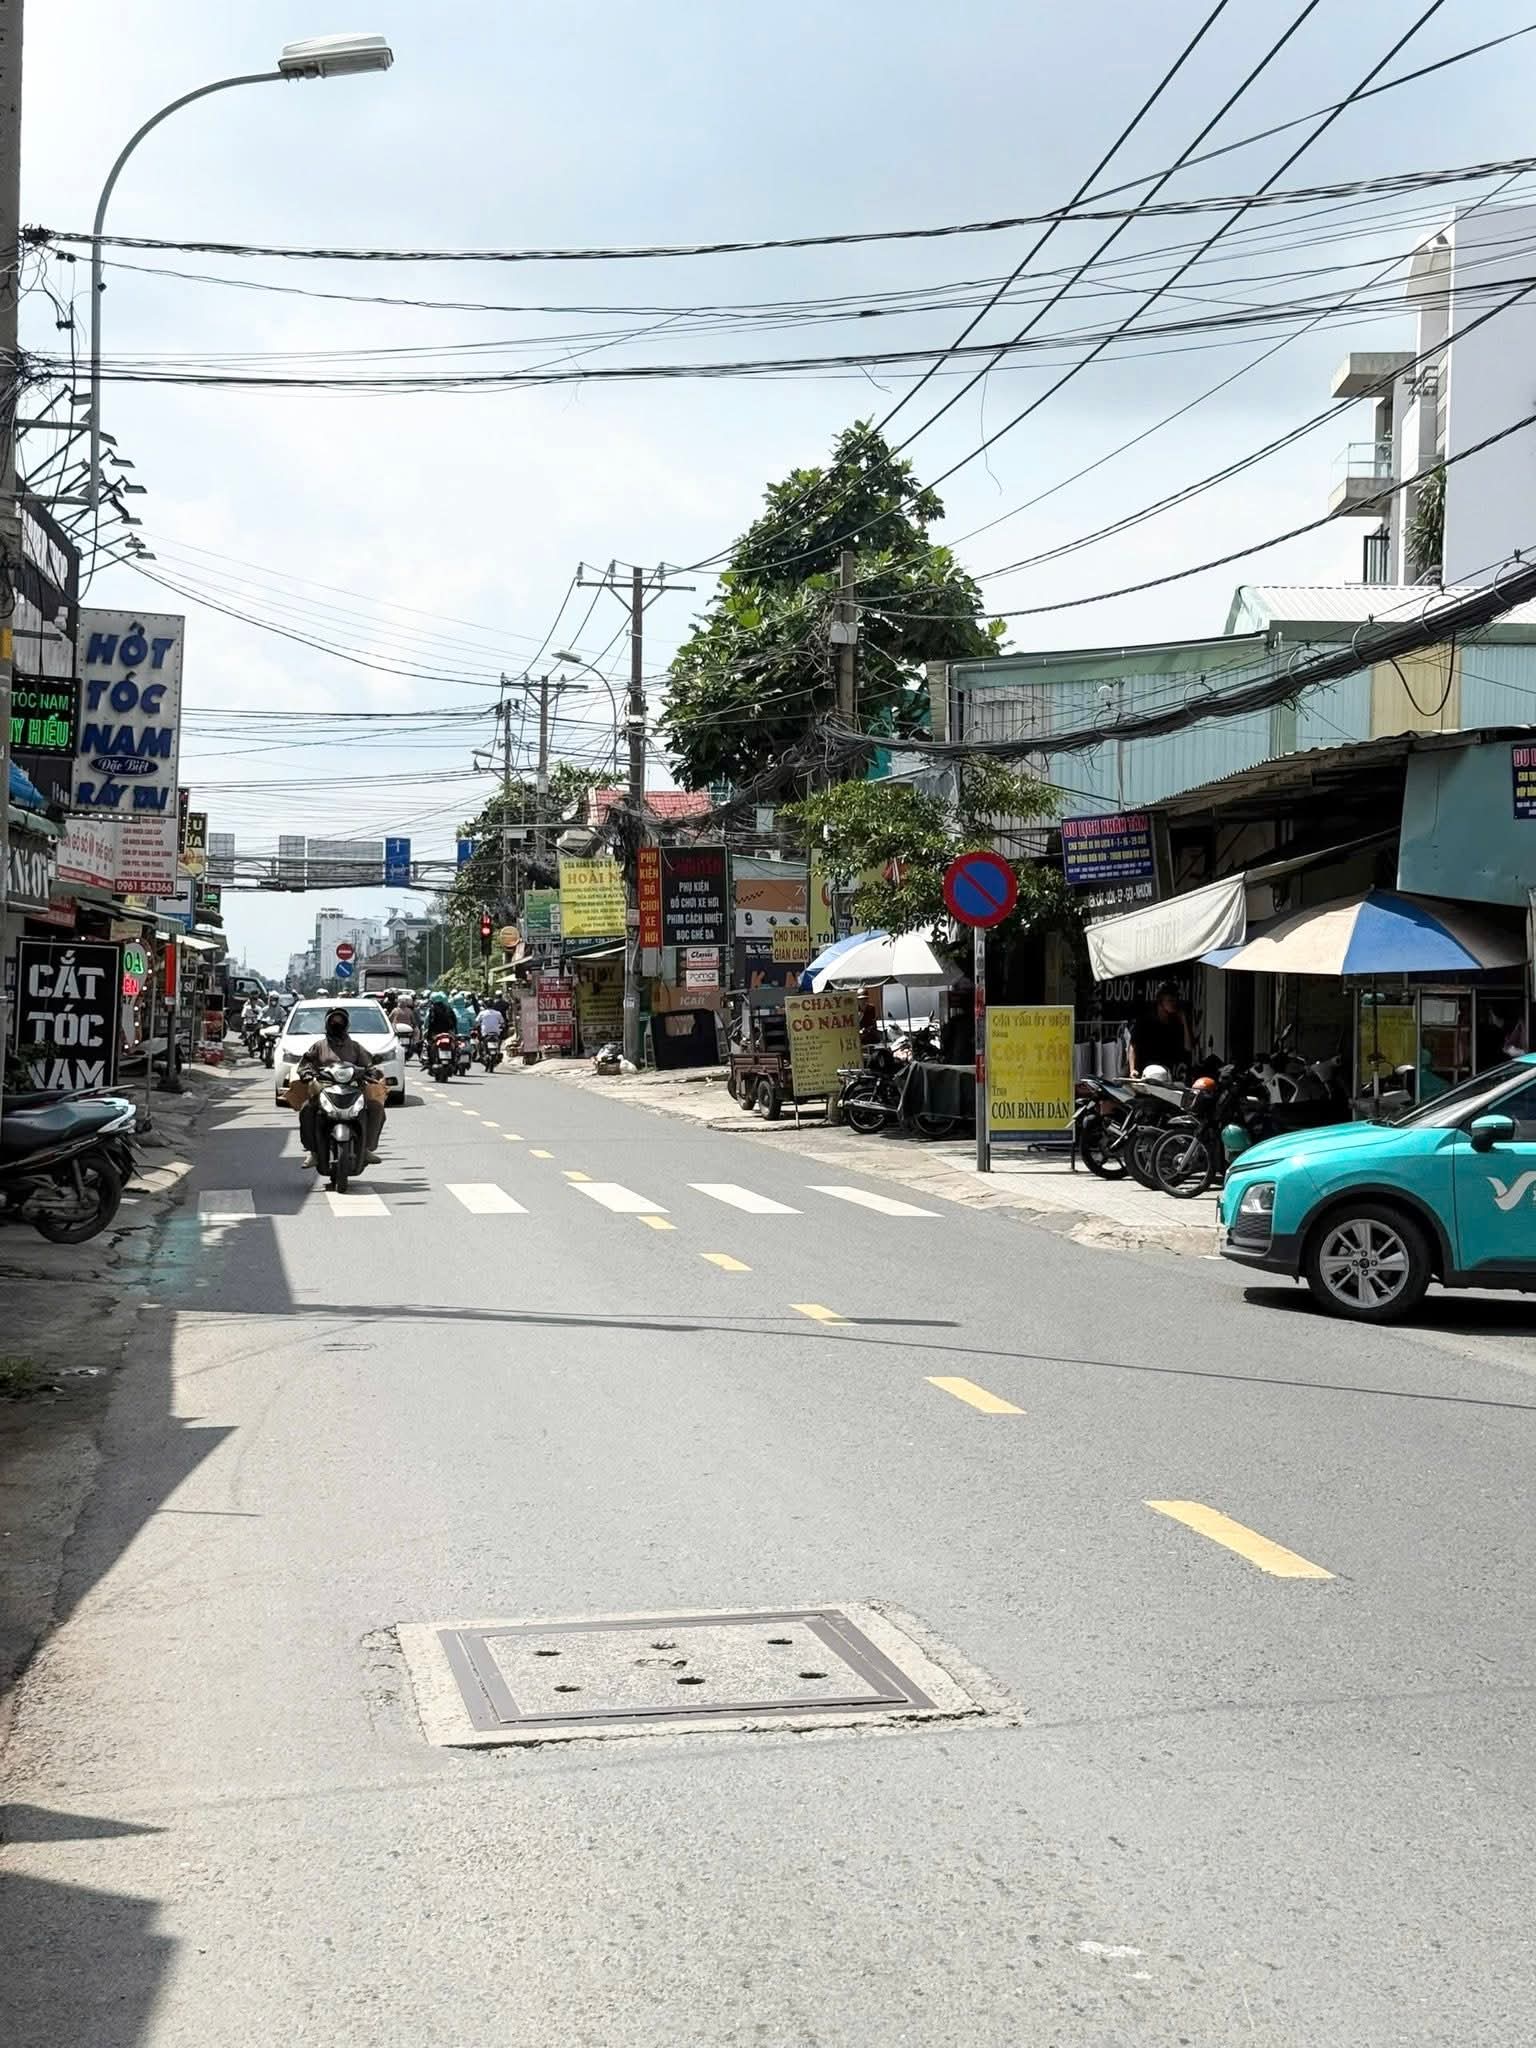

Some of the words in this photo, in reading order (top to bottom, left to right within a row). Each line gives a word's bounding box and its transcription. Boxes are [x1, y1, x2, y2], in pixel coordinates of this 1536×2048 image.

[87, 671, 168, 714] TÓC
[40, 693, 69, 711] NAM
[80, 723, 176, 759] NAM
[1063, 821, 1078, 838] DU
[640, 851, 657, 865] PHỤ
[567, 869, 604, 885] HOÀI
[116, 881, 138, 892] 0961
[140, 882, 173, 894] 543366
[679, 881, 692, 895] PHỤ
[698, 897, 706, 908] XE
[645, 915, 656, 927] XE
[774, 930, 788, 942] CHO
[29, 950, 105, 1000] CẮT
[560, 997, 571, 1009] XE
[801, 996, 843, 1012] CHAY
[27, 1004, 104, 1047] TÓC
[792, 1014, 813, 1033] CÔ
[818, 1011, 855, 1030] NĂM
[991, 1100, 1016, 1120] CƠM
[1018, 1097, 1044, 1120] BÌNH
[1047, 1097, 1070, 1120] DÂN
